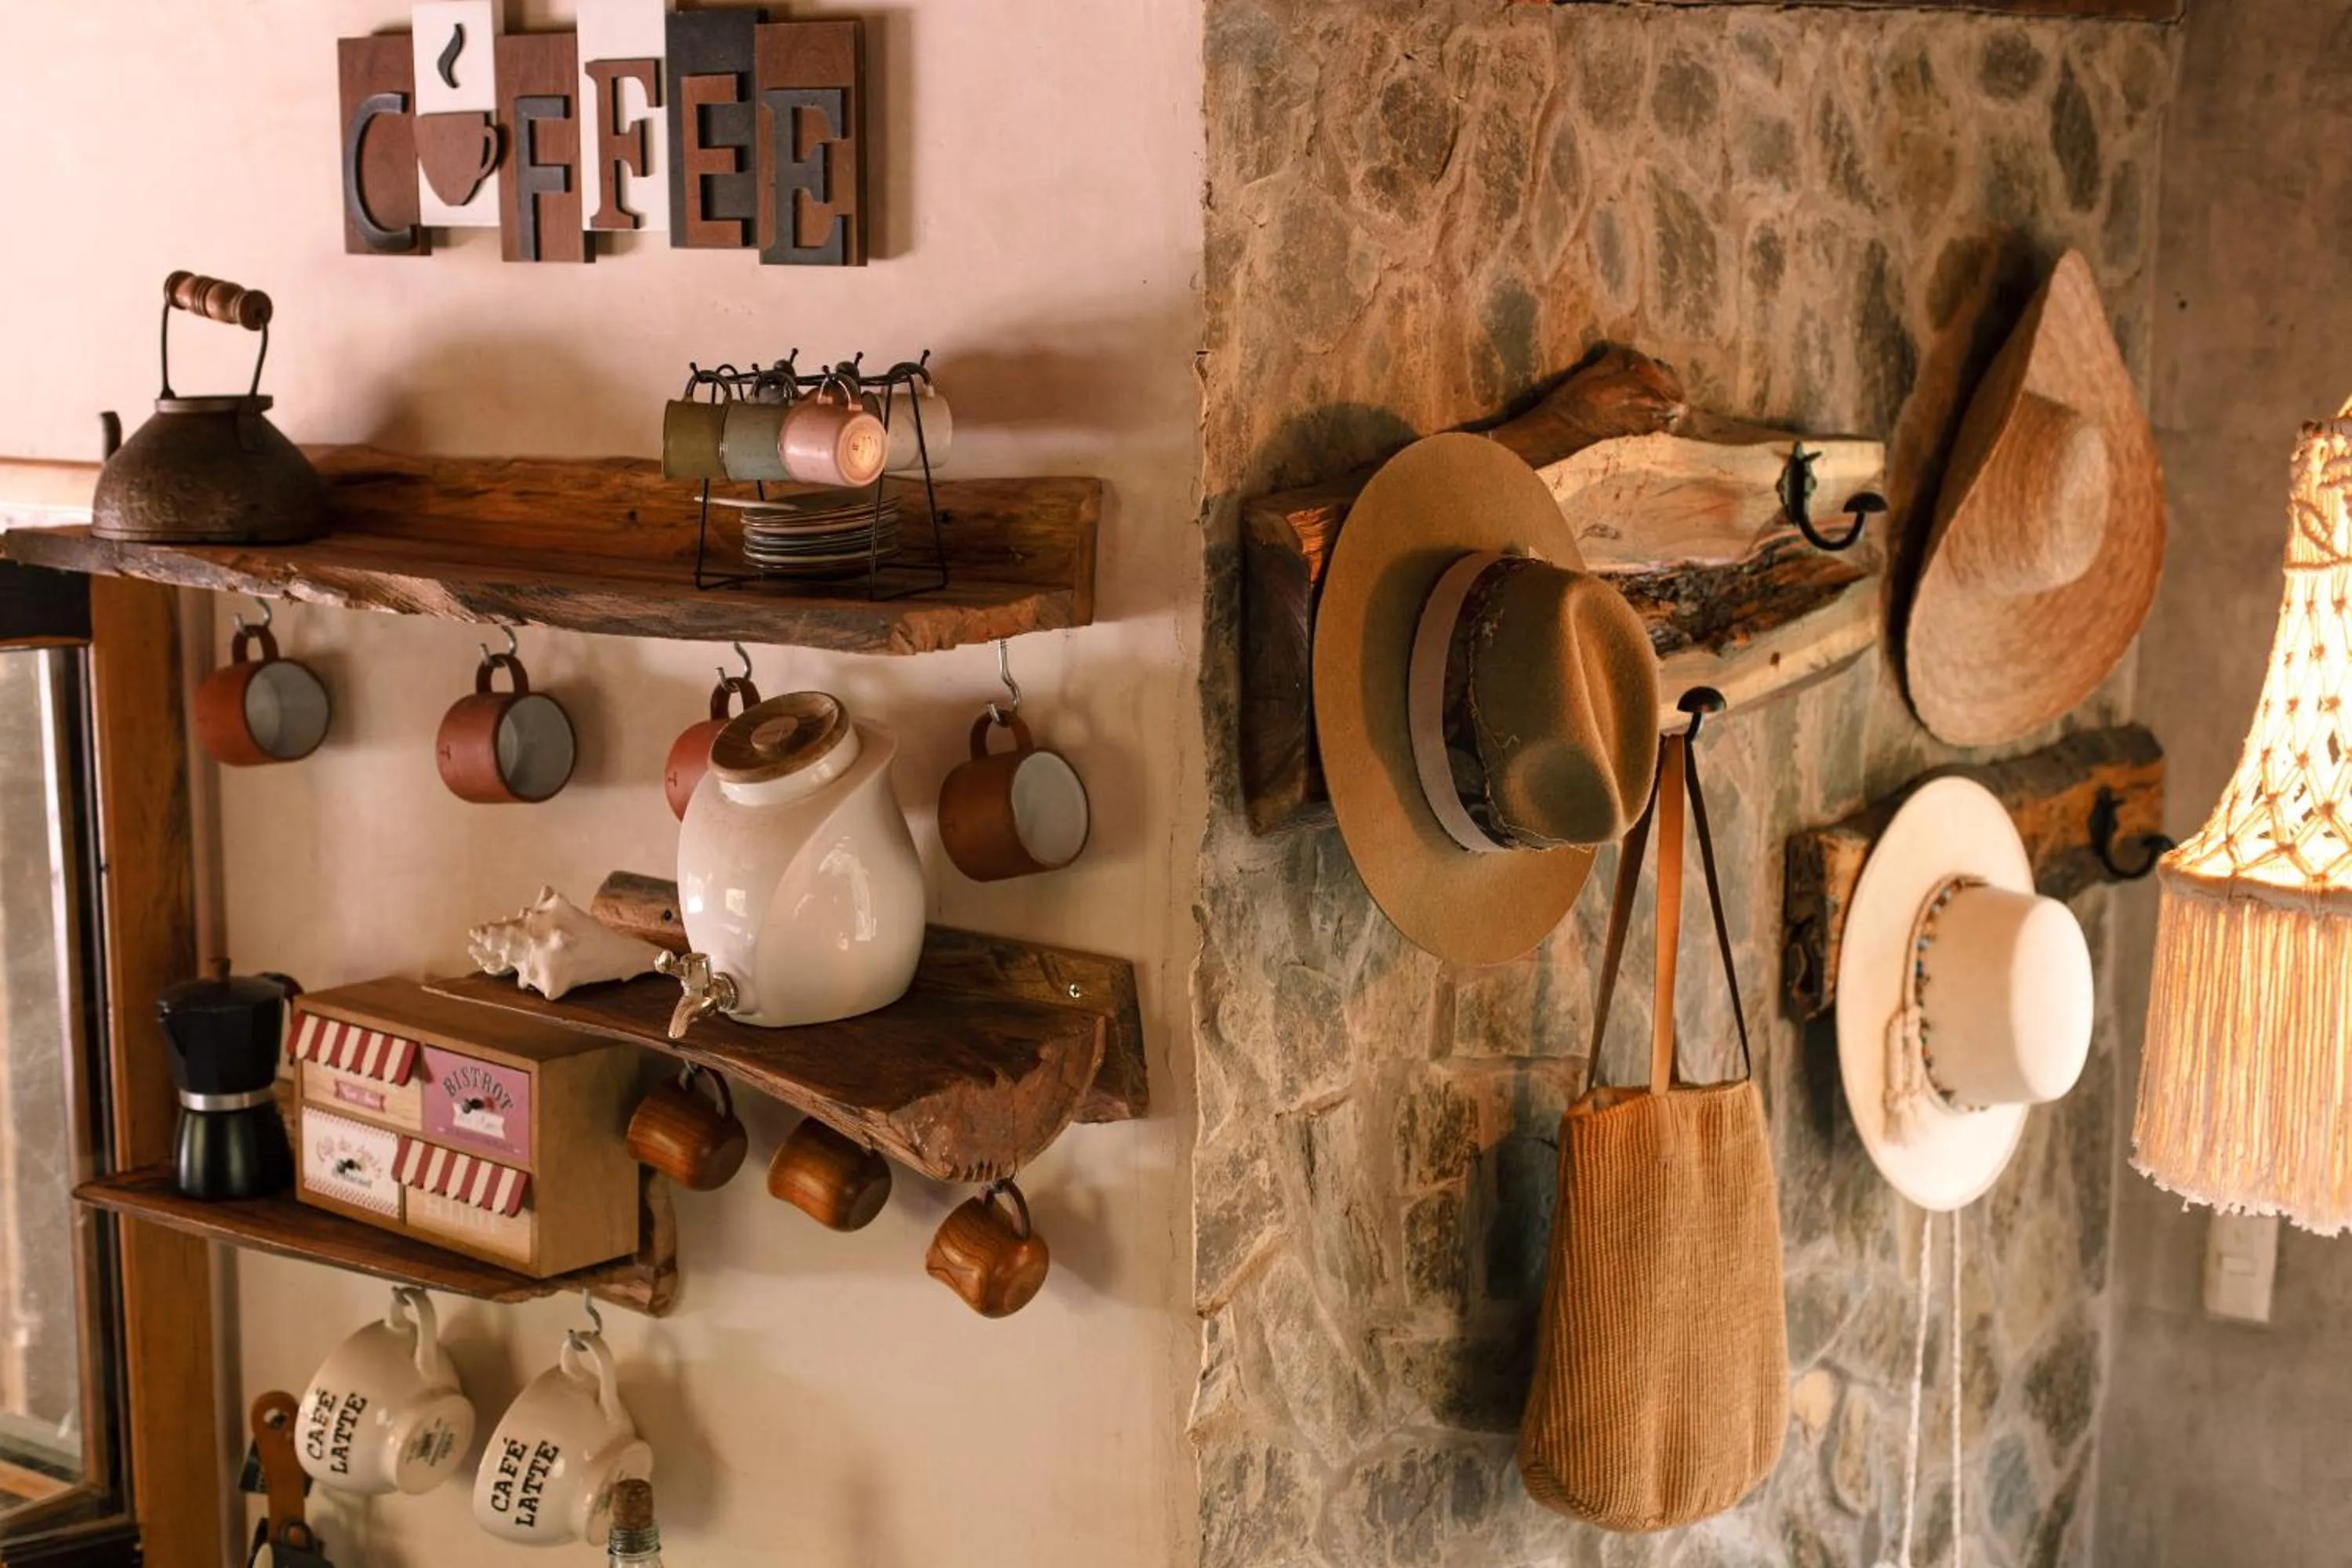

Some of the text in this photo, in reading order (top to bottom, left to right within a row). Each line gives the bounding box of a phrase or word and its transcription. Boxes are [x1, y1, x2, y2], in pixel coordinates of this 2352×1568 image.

[443, 1066, 514, 1109] BISTROT
[307, 1387, 336, 1460] CAFÉ
[331, 1392, 367, 1474] LATTE
[491, 1437, 528, 1512] CAFÉ
[515, 1440, 560, 1527] LATTE
